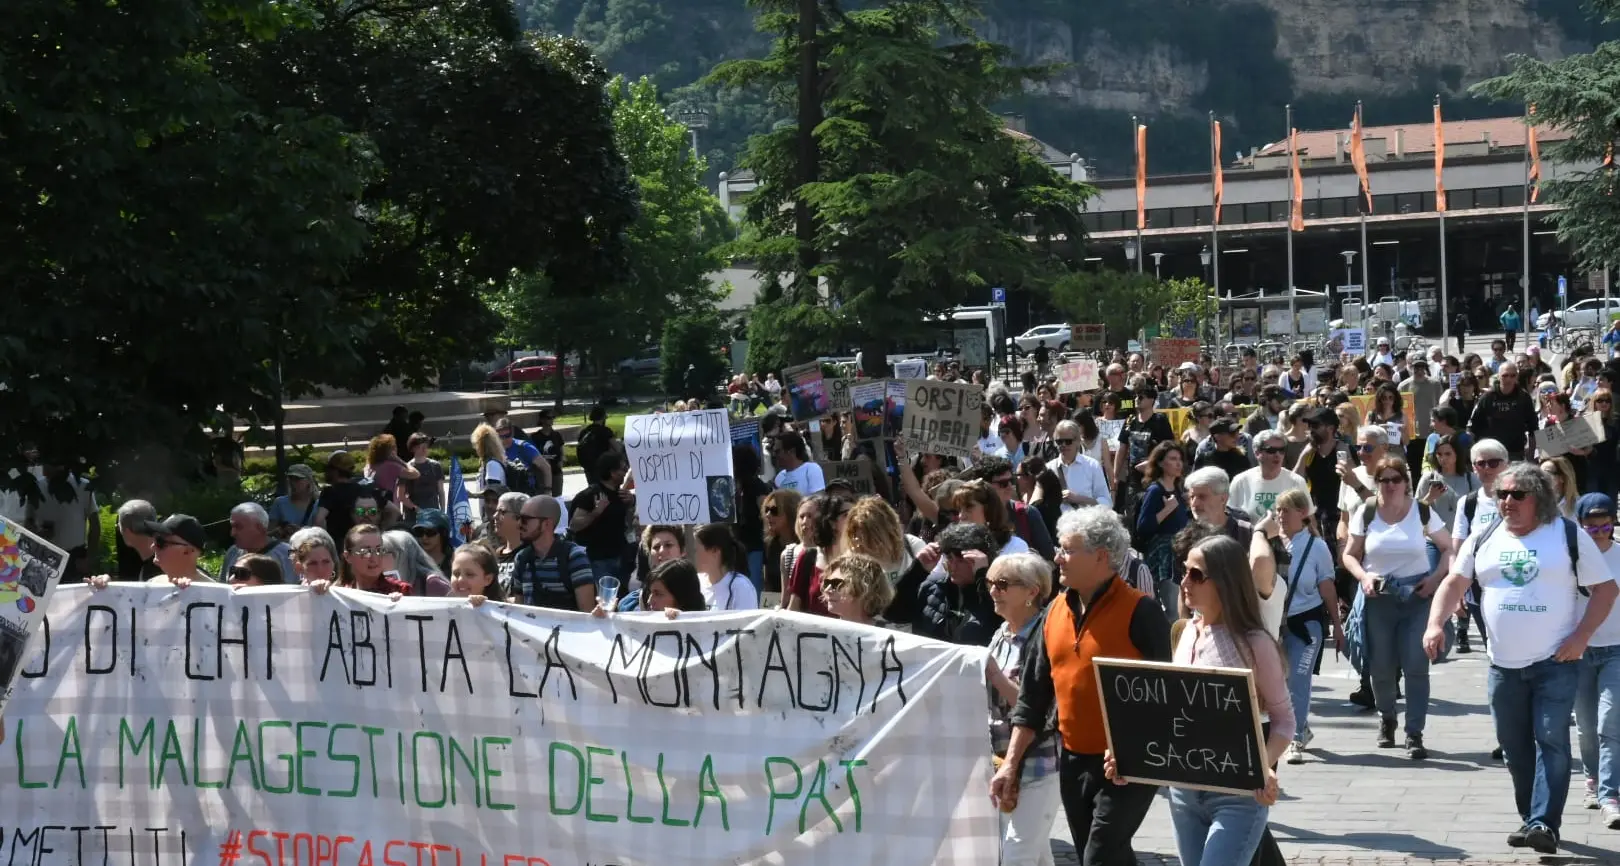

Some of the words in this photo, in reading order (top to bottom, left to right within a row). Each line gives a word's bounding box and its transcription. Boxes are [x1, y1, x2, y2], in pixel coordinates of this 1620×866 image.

[995, 290, 1002, 300] P
[915, 386, 965, 417] ORSI
[628, 415, 685, 449] SIAMO
[691, 412, 725, 445] TUTTI
[910, 414, 970, 447] LIBERI
[638, 453, 678, 482] OSPITI
[689, 451, 704, 479] DI
[647, 492, 701, 522] QUESTO
[1499, 549, 1537, 564] STOP
[1498, 603, 1547, 613] CASTELLER
[85, 604, 135, 677] DI
[184, 602, 273, 681] CHI
[320, 609, 475, 694] ABITA
[504, 622, 577, 700] LA
[606, 629, 907, 715] MONTAGNA
[1114, 674, 1168, 704] OGNI
[1180, 679, 1242, 712] VITA
[15, 717, 87, 790] LA
[119, 716, 516, 811] MALAGESTIONE
[548, 741, 730, 831] DELLA
[764, 756, 868, 836] PAT
[0, 825, 186, 866] METTITI
